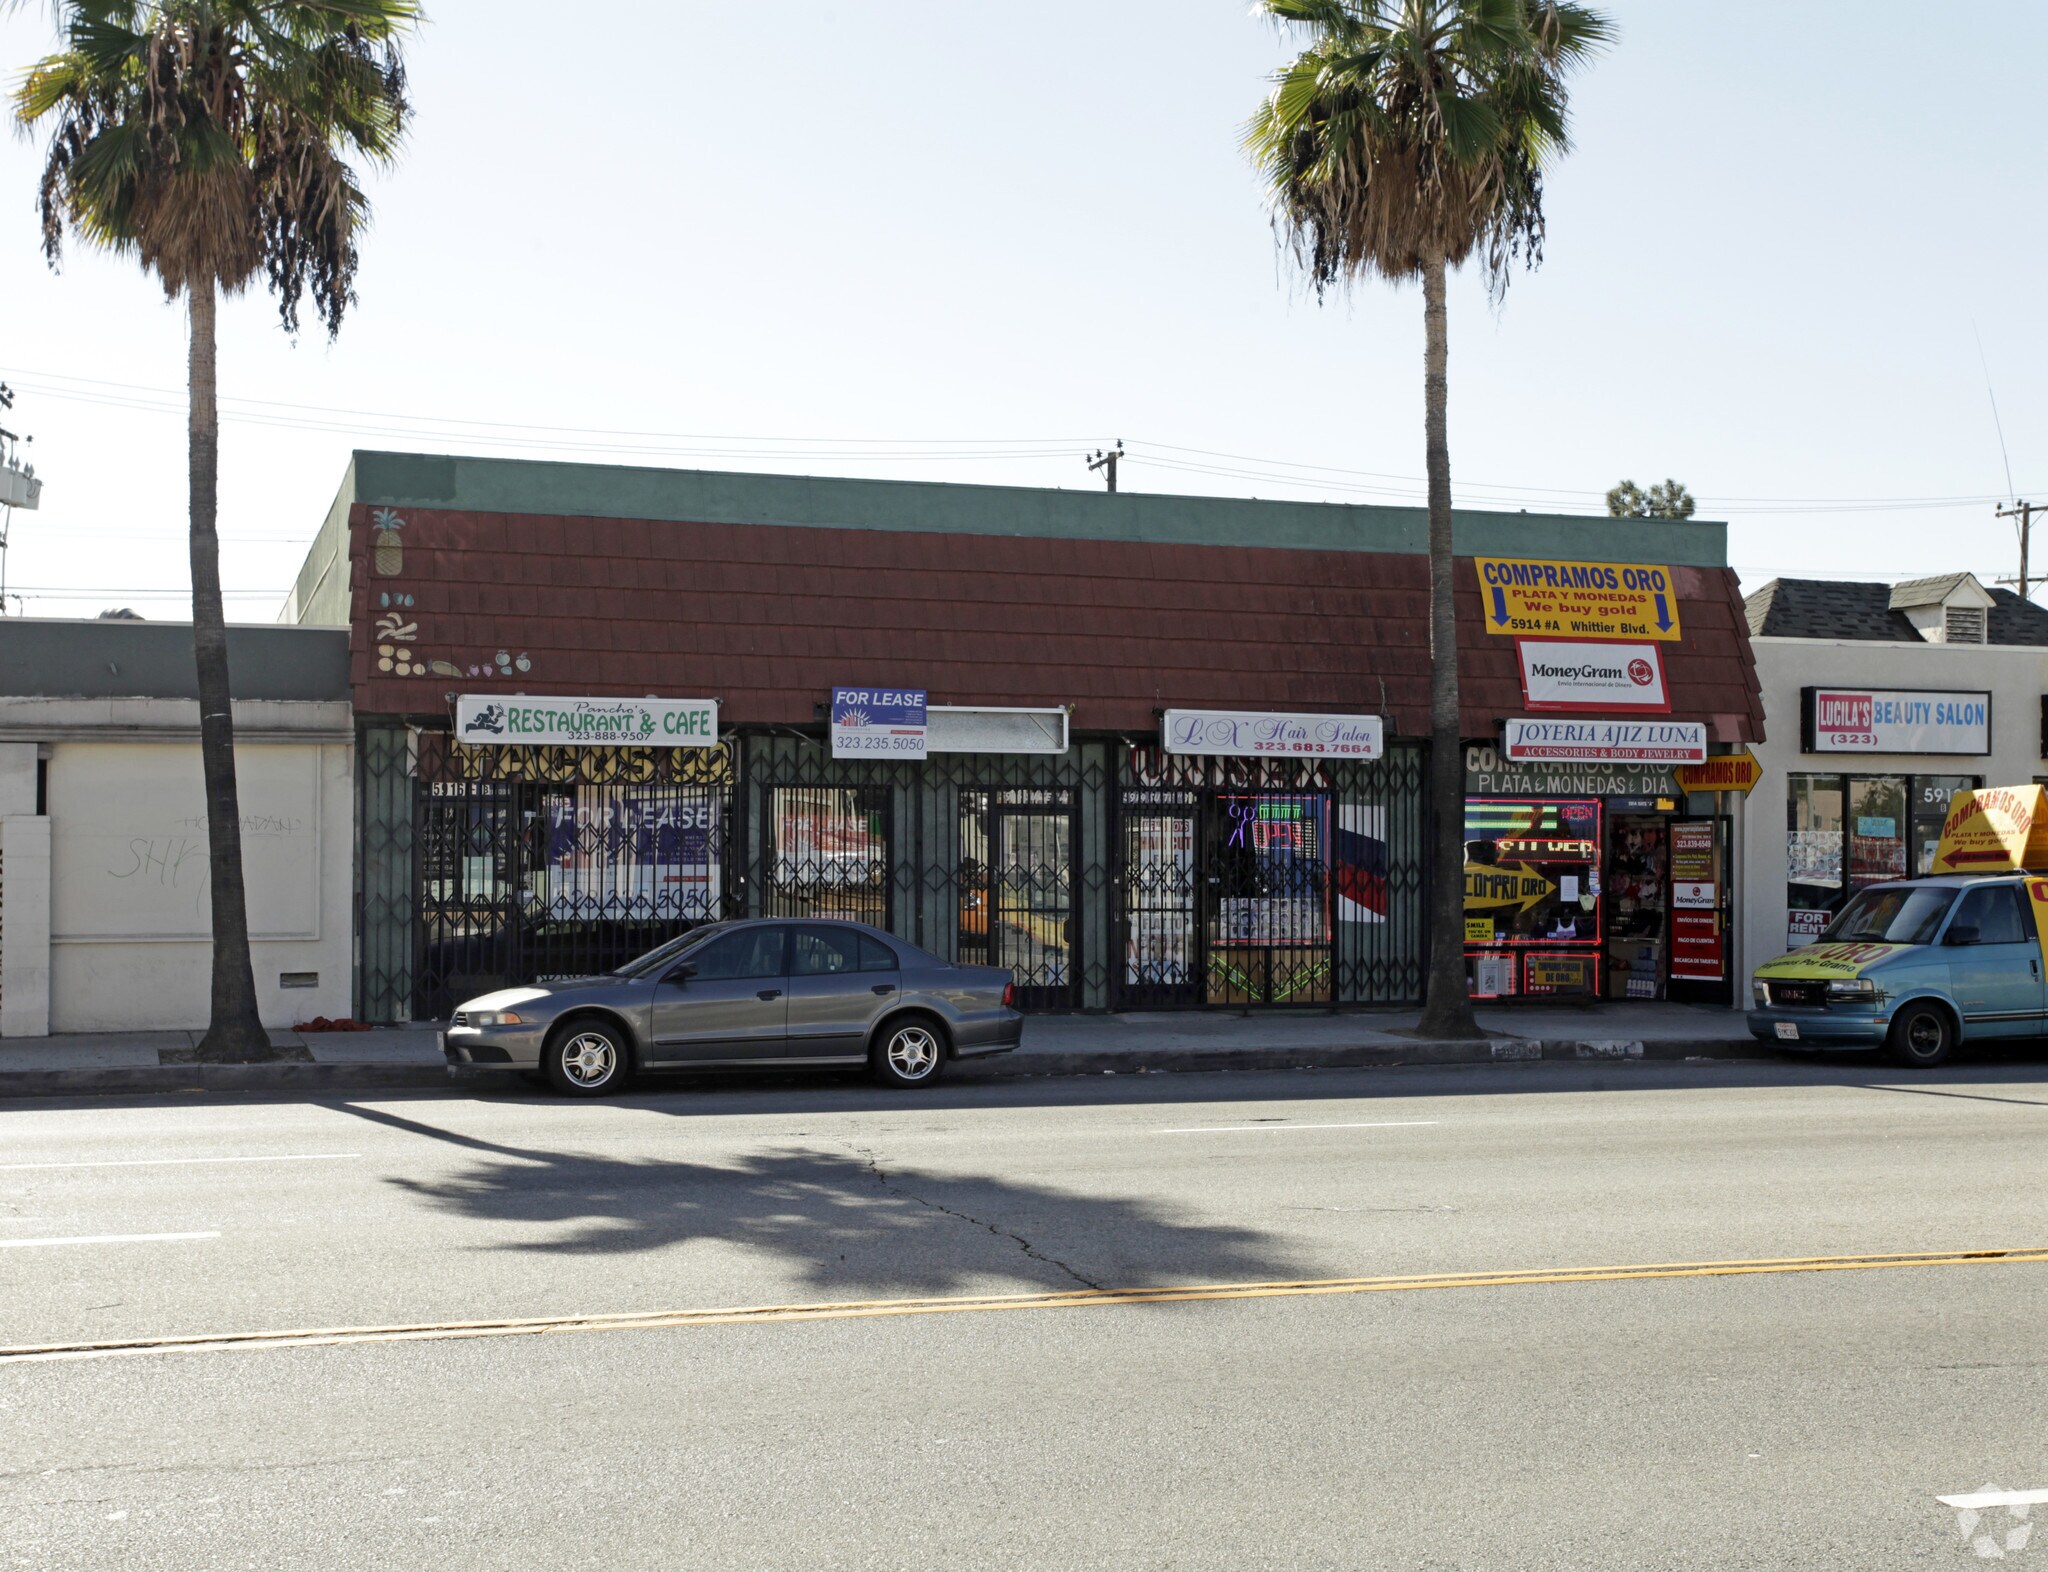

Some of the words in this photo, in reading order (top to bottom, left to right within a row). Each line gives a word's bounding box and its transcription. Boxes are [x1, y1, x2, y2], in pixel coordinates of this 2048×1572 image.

[1483, 562, 1619, 590] COMPRAMOS
[1623, 568, 1666, 592] ORO
[1512, 589, 1557, 600] PLATA
[1561, 591, 1570, 600] Y
[1573, 592, 1648, 602] MONEDAS
[1524, 601, 1554, 612] We
[1559, 602, 1592, 616] buy
[1598, 605, 1638, 617] gold
[1511, 618, 1542, 630] 5914
[1545, 620, 1561, 631] #A
[1570, 620, 1615, 633] Whittier
[1620, 622, 1650, 634] Blvd.
[1531, 663, 1623, 680] MoneyGram
[836, 691, 869, 705] FOR
[872, 692, 924, 707] LEASE
[573, 701, 647, 714] Pancho's
[1819, 700, 1871, 728] LUCILA'S
[1874, 701, 1931, 724] BEAUTY
[1935, 703, 1985, 725] SALON
[508, 707, 634, 733] RESTAURANT
[640, 714, 656, 733] &
[663, 710, 711, 736] CAFE
[568, 731, 651, 741] 323-888-9507
[1254, 718, 1308, 740] Hair
[1315, 719, 1372, 742] Salon
[1514, 724, 1596, 746] JOYERIA
[1602, 725, 1643, 747] AJIZ
[1649, 727, 1699, 743] LUNA
[836, 736, 924, 750] 323.235.5050
[1254, 741, 1372, 754] 323.683.7664
[1830, 734, 1878, 745] (323)
[1523, 748, 1597, 758] ACCESSORIES
[1600, 749, 1608, 758] &
[1610, 749, 1639, 758] BODY
[1642, 750, 1691, 759] JEWELRY
[451, 739, 656, 785] TACOS
[1131, 748, 1333, 788] UNISEX
[1683, 761, 1733, 785] COMPRAMOS
[1735, 761, 1752, 783] ORO
[1479, 774, 1532, 793] PLATA
[1547, 775, 1626, 794] MONEDAS
[1642, 776, 1669, 794] DIA
[1923, 788, 1963, 803] 591
[555, 807, 615, 829] FOR
[620, 807, 710, 829] LEASE
[1561, 807, 1594, 819] OPEN
[1944, 789, 2015, 839] COMPRAMOS
[2010, 800, 2031, 834] ORO
[1254, 822, 1302, 847] OPEN
[1980, 829, 2016, 837] MONEDAS
[1987, 837, 2008, 845] gold
[1463, 872, 1518, 900] COMPRO
[1521, 877, 1547, 896] ORO
[1794, 912, 1824, 923] FOR
[1790, 923, 1828, 934] RENT
[1819, 942, 1893, 964] ORO
[1800, 958, 1819, 967] Por
[1819, 960, 1857, 973] Gramo
